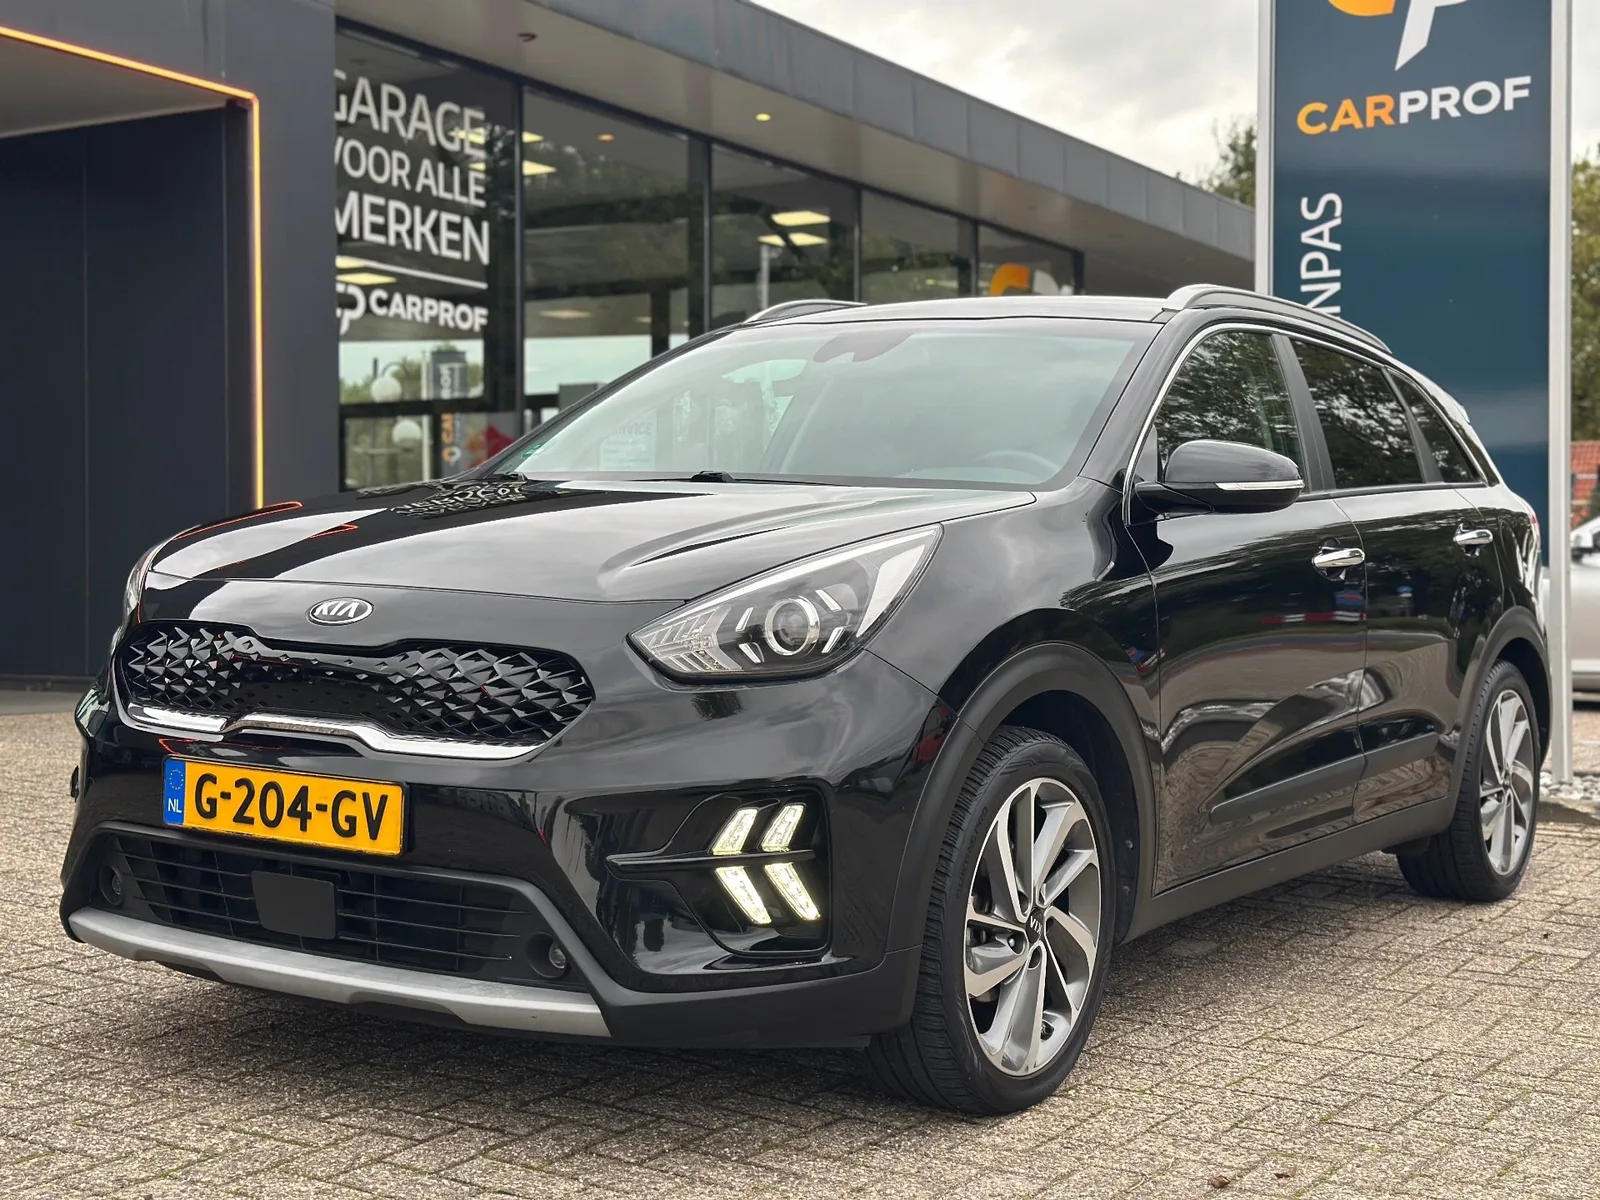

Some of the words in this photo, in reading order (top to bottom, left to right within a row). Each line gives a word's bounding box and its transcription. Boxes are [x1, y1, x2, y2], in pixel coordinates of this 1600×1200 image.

[1297, 75, 1532, 135] CARPROF
[415, 157, 486, 208] ALLE
[334, 190, 490, 266] MERKEN
[1300, 193, 1343, 319] NPAS
[369, 288, 489, 332] CARPROF
[314, 600, 359, 618] KIA
[167, 798, 182, 814] NL
[194, 773, 389, 841] G-204-GV
